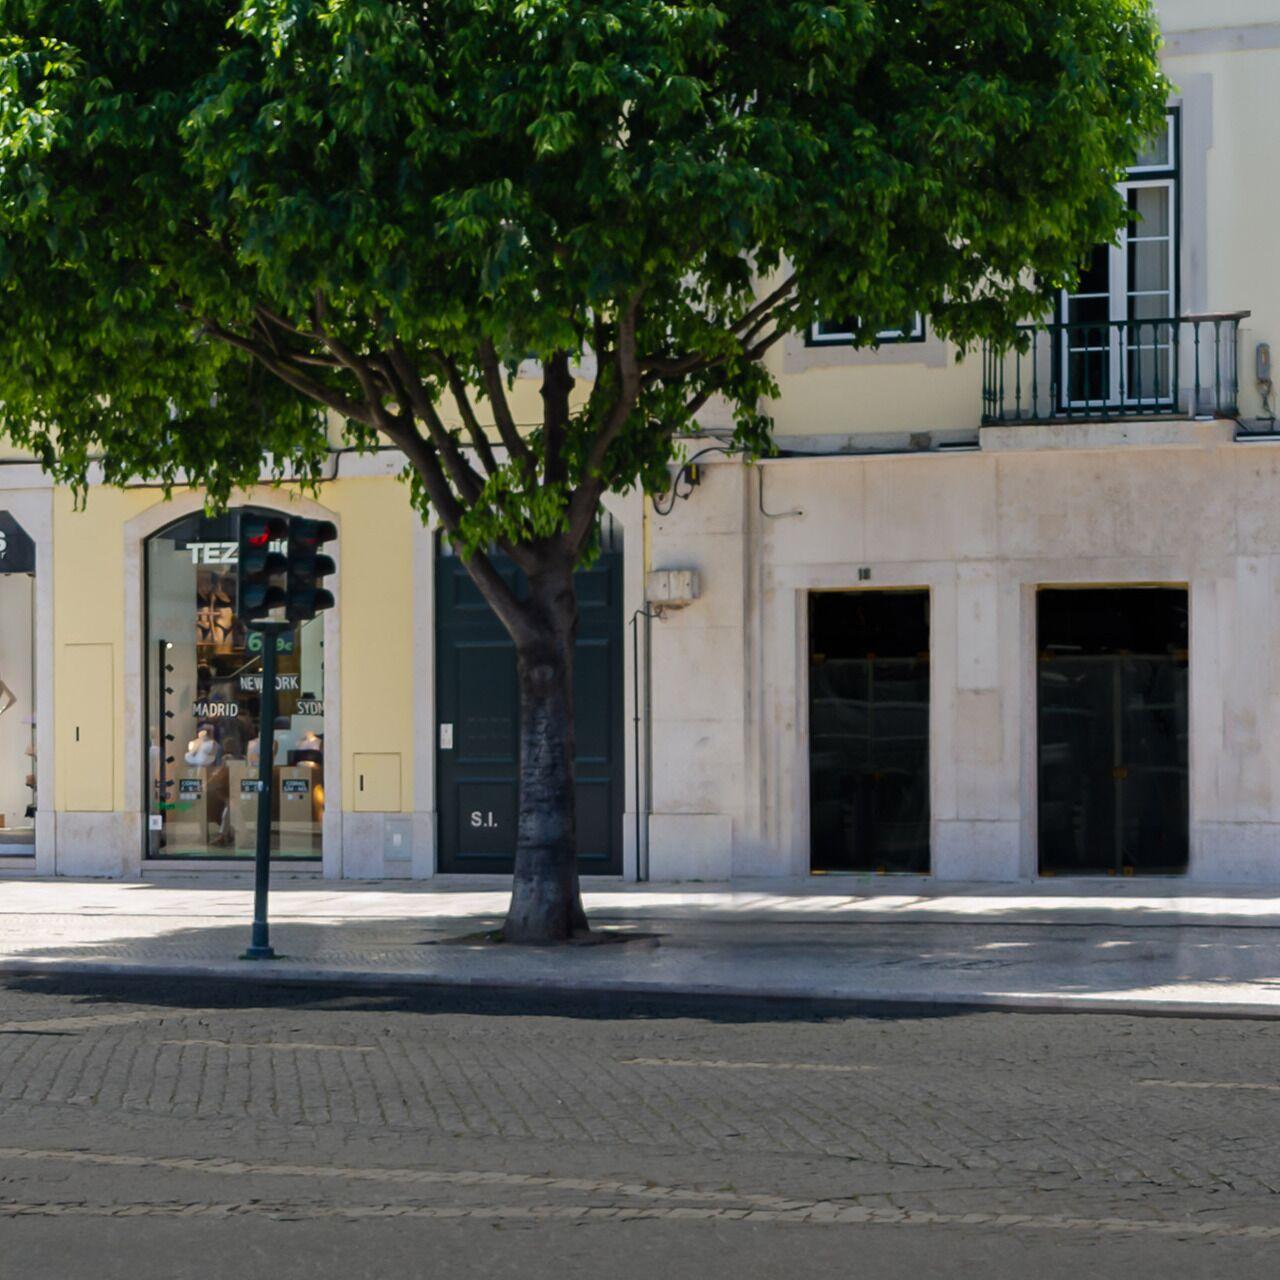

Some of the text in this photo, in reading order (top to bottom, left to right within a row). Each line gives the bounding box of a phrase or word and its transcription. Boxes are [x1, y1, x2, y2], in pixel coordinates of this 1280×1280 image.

[273, 675, 299, 690] ORK
[193, 702, 239, 717] MADRID
[471, 811, 498, 827] S.I.
